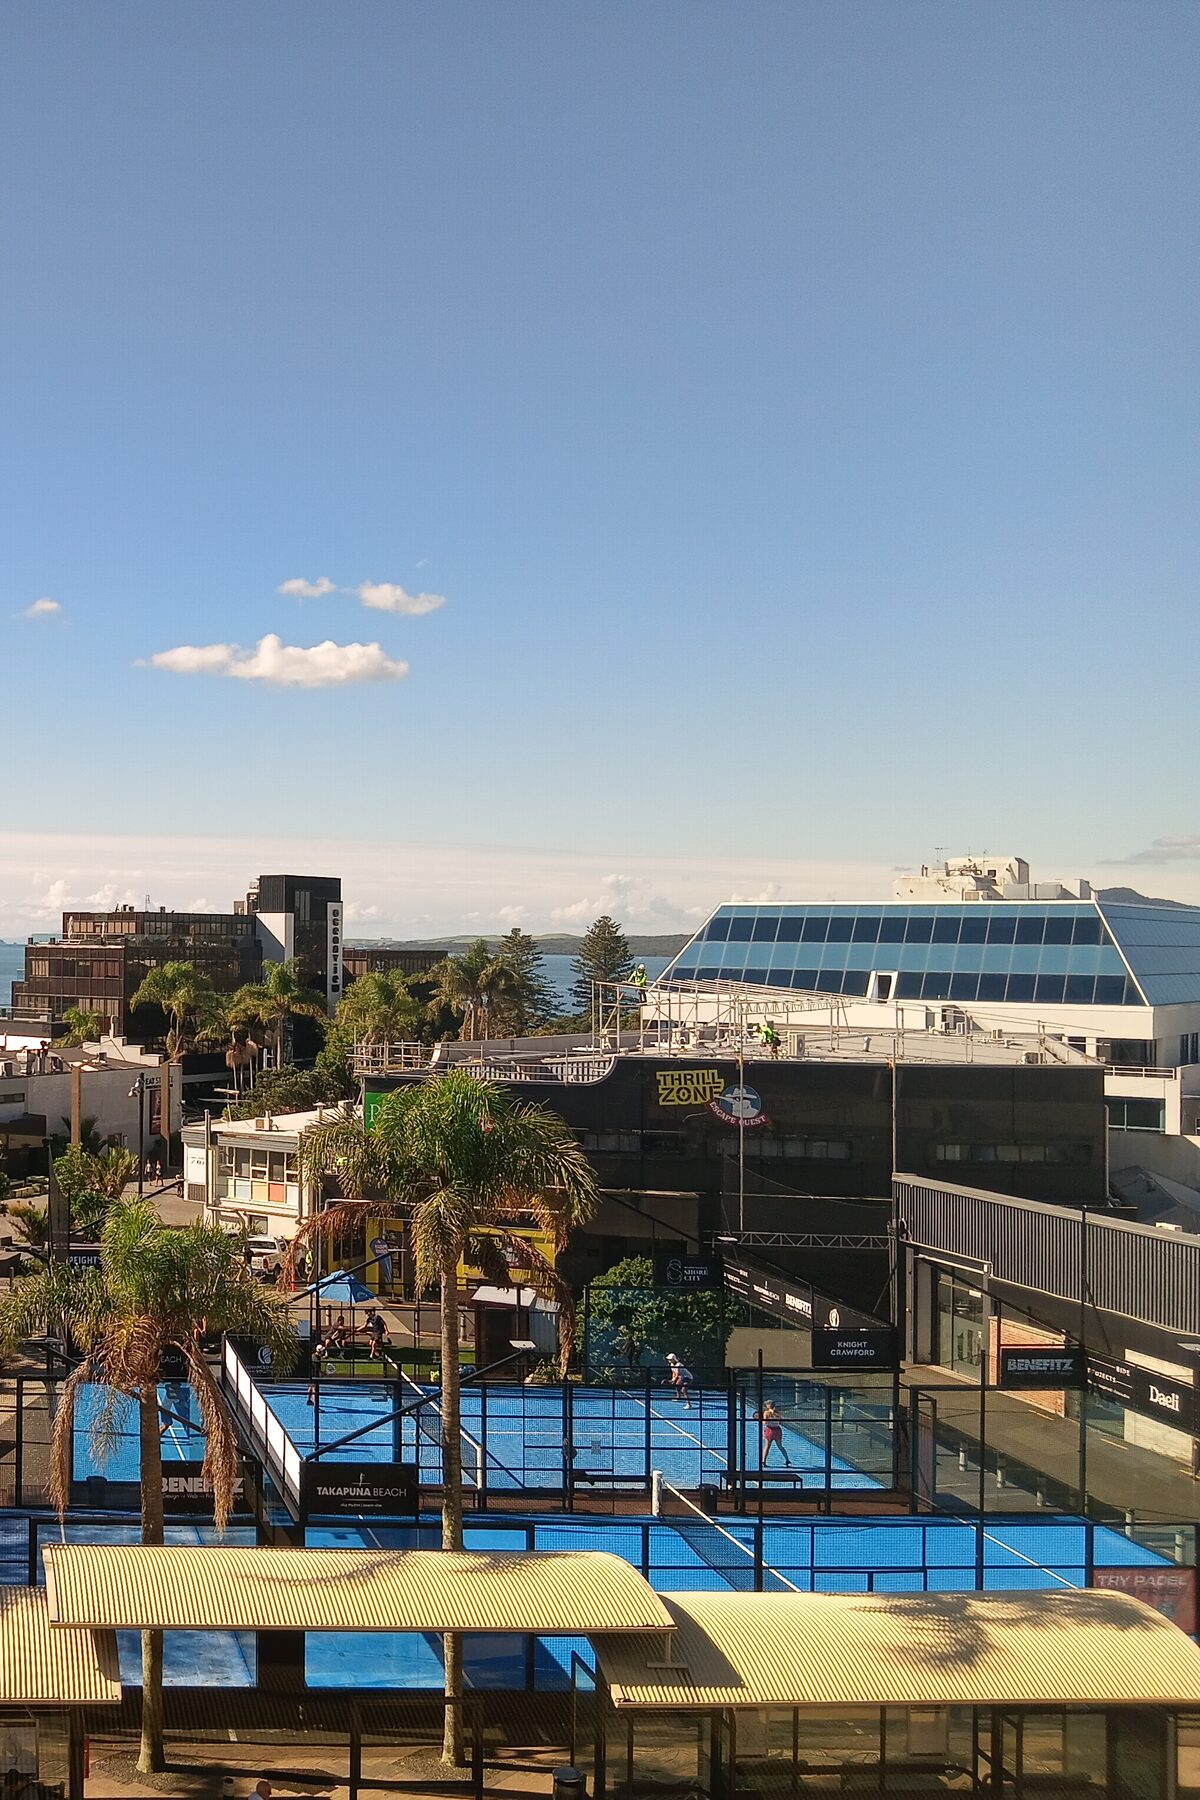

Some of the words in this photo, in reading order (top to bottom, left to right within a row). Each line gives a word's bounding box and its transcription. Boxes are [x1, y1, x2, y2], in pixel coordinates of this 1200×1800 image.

[659, 1072, 722, 1086] THRILL
[660, 1086, 722, 1103] ZONE
[710, 1102, 737, 1124] ESCAPE
[1007, 1359, 1074, 1371] BENEFITZ
[1149, 1384, 1180, 1412] Daeli
[161, 1477, 244, 1493] BENEFZ
[316, 1486, 371, 1496] TAKAPUNA
[373, 1488, 407, 1497] BEACH
[1097, 1575, 1130, 1586] TRY
[1134, 1575, 1188, 1586] PADEL
